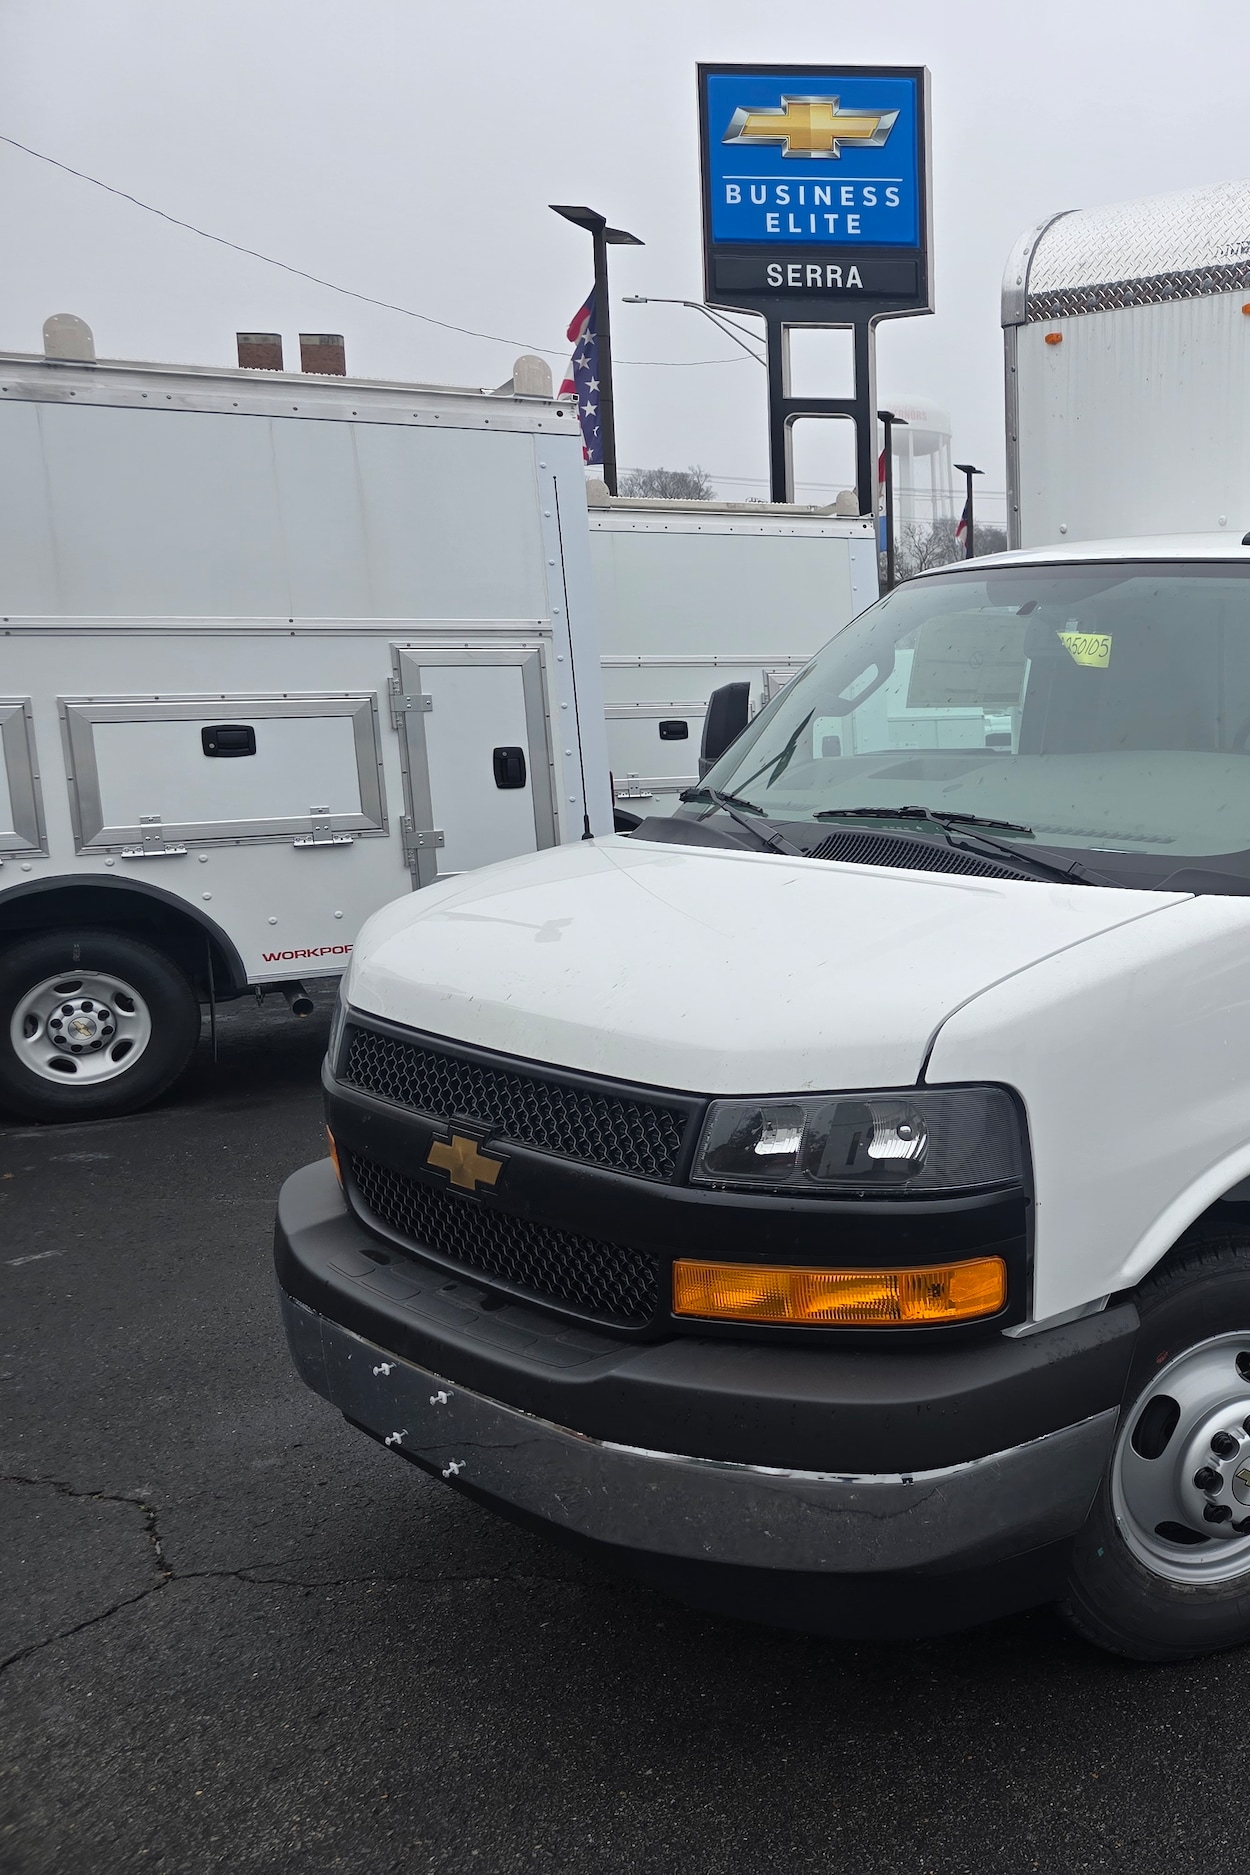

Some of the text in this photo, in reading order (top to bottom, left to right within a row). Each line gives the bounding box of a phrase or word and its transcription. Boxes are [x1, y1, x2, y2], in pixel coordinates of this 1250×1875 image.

[725, 184, 900, 207] BUSINESS
[766, 213, 861, 234] ELITE
[766, 263, 863, 288] SERRA
